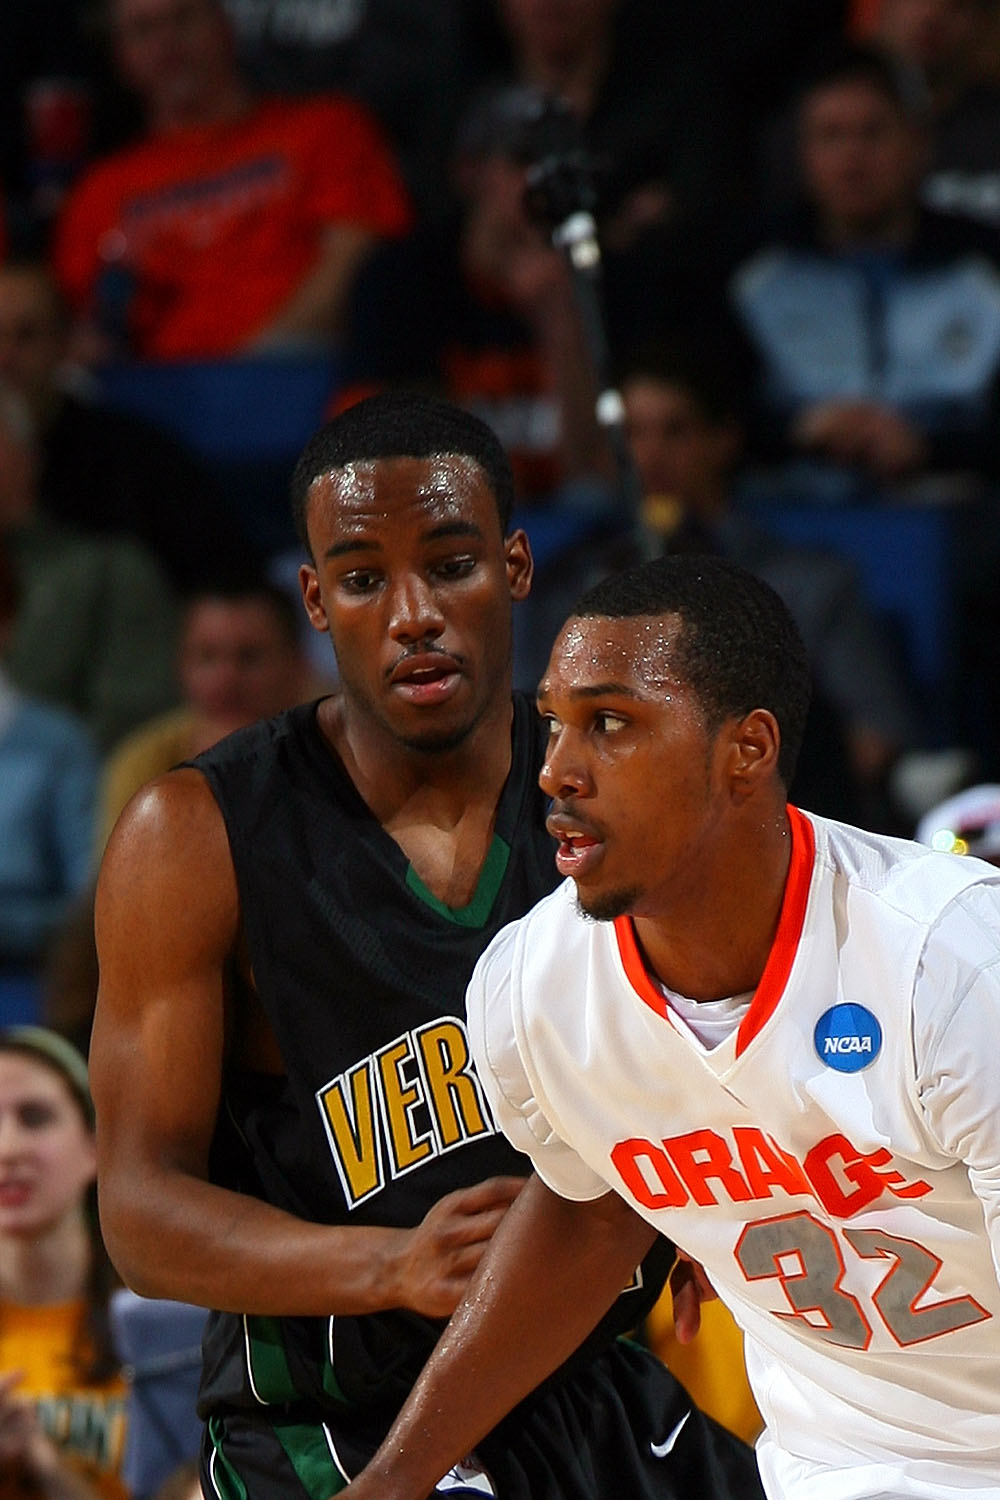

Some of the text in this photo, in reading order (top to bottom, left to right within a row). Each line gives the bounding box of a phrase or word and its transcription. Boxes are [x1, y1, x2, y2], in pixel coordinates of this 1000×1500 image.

[823, 1035, 872, 1054] NCAA
[316, 1015, 501, 1211] VER
[610, 1126, 934, 1219] ORAGE
[733, 1209, 993, 1351] 32
